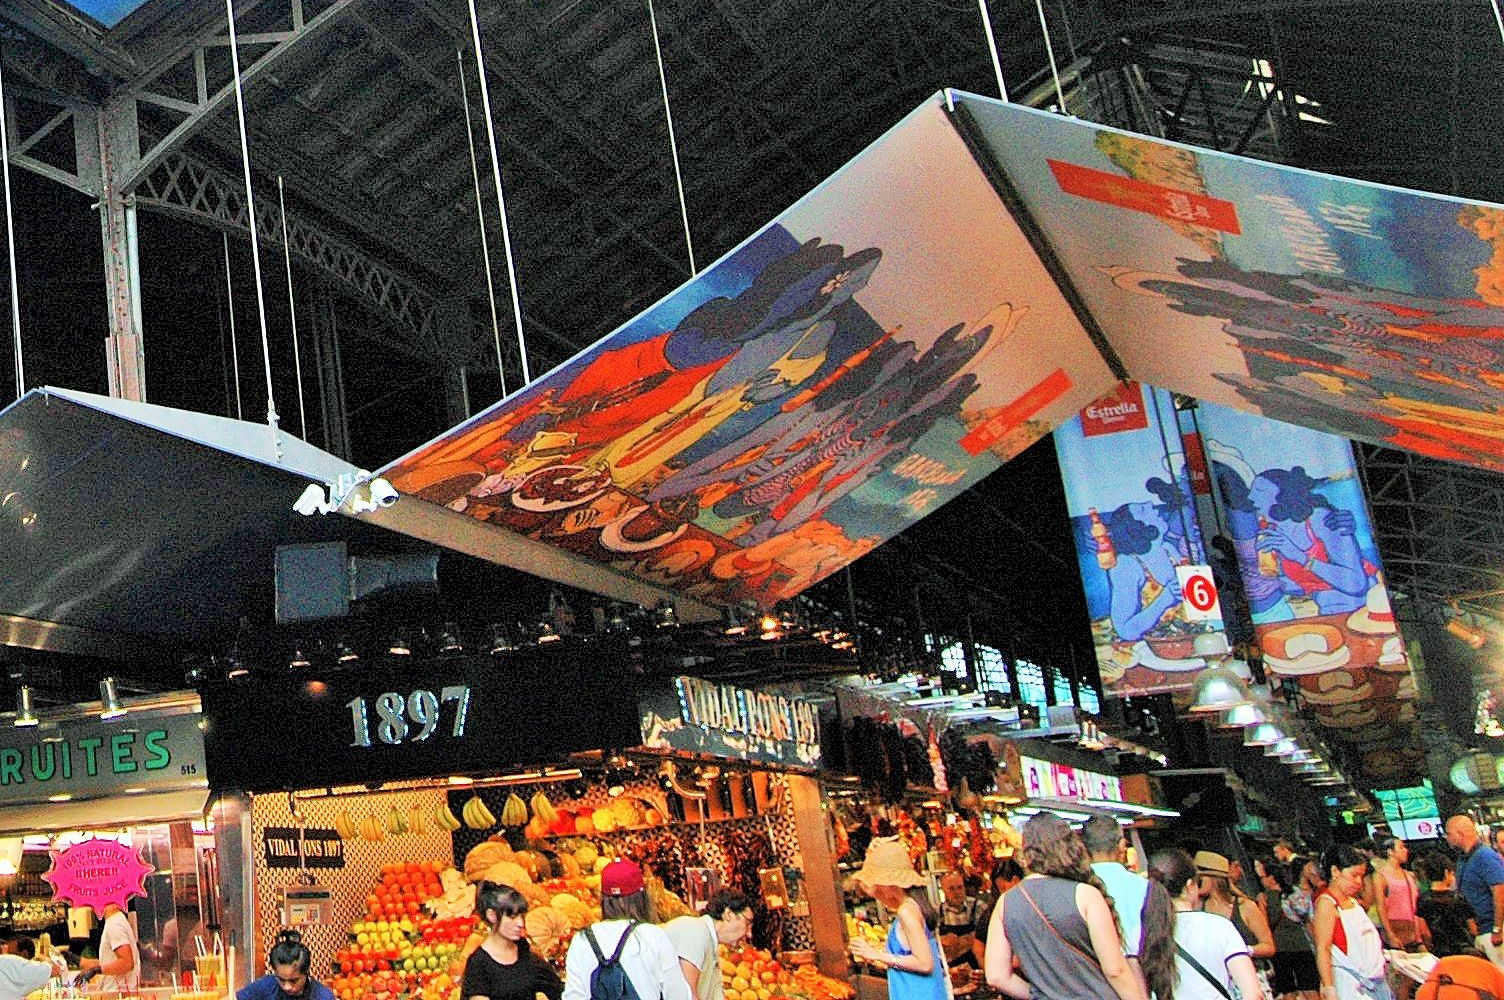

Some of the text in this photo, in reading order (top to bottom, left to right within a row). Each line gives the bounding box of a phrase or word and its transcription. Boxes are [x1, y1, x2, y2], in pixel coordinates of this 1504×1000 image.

[1193, 580, 1209, 606] 6
[346, 685, 471, 747] 1897
[87, 847, 130, 867] NATURAL
[267, 838, 298, 857] VIDAL
